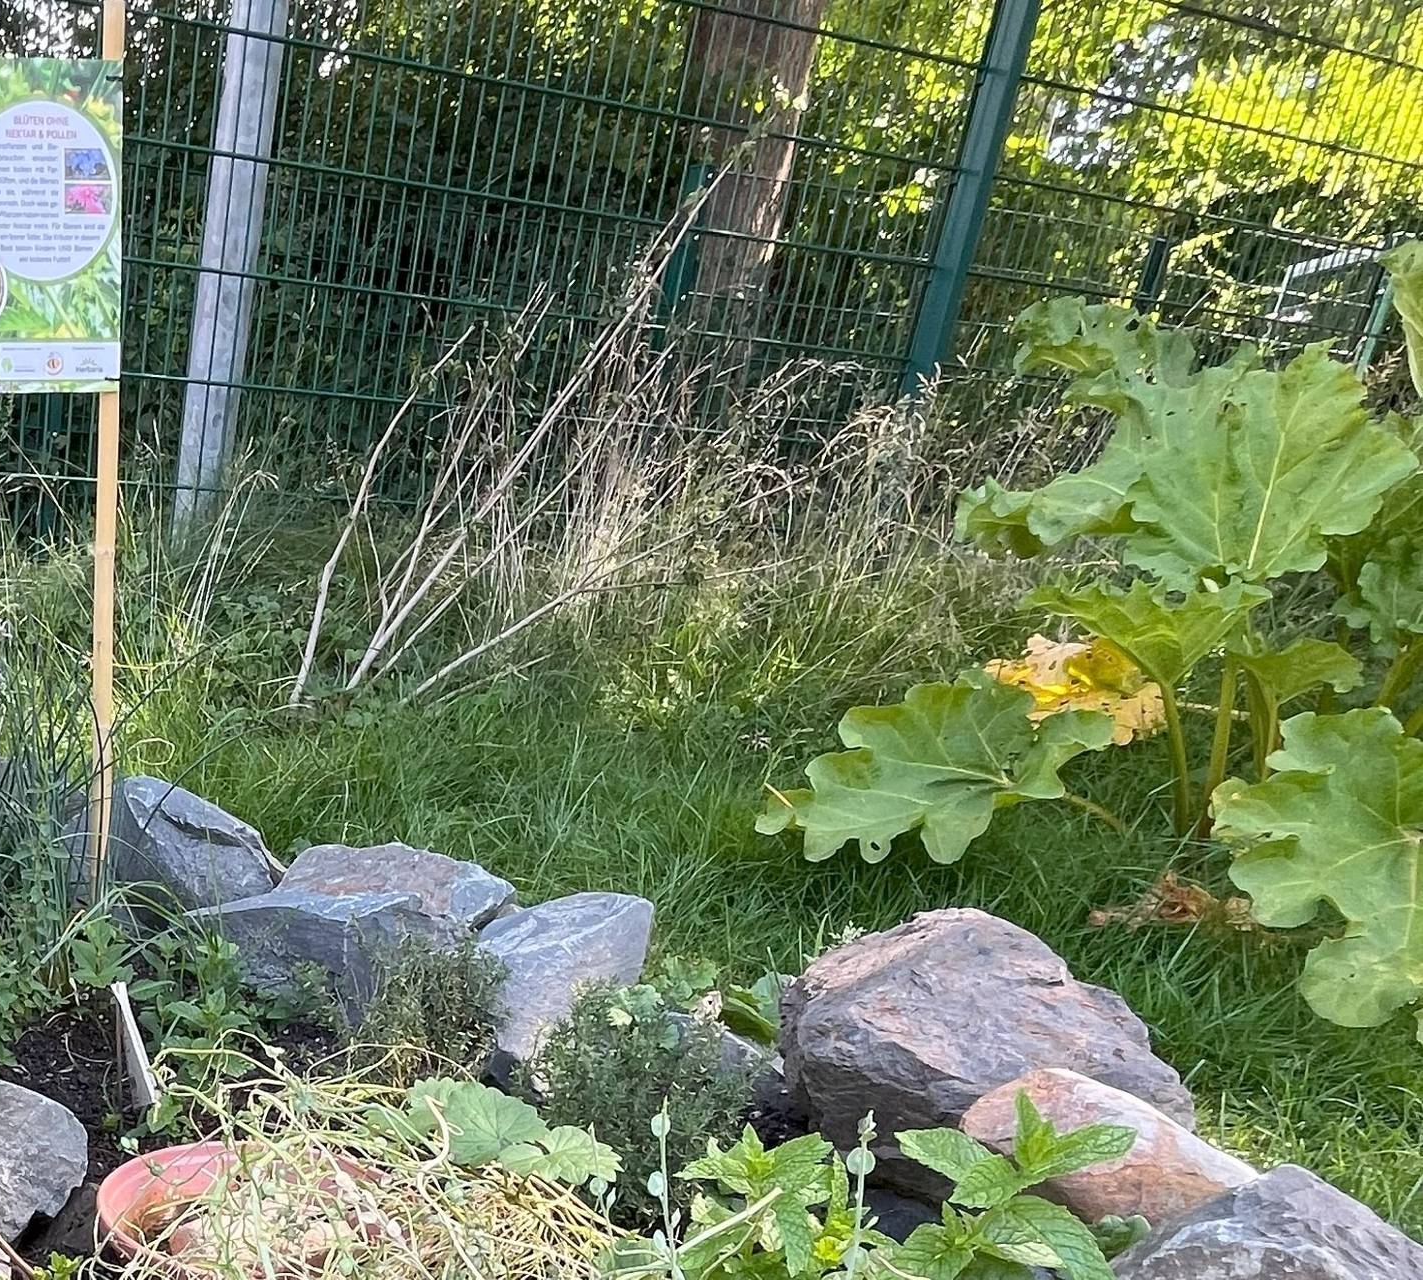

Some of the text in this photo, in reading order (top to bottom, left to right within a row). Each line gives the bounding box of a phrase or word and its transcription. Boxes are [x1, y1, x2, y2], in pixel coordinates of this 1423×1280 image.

[13, 114, 69, 125] BLÜTEN OHNE
[46, 131, 77, 139] POLLEN
